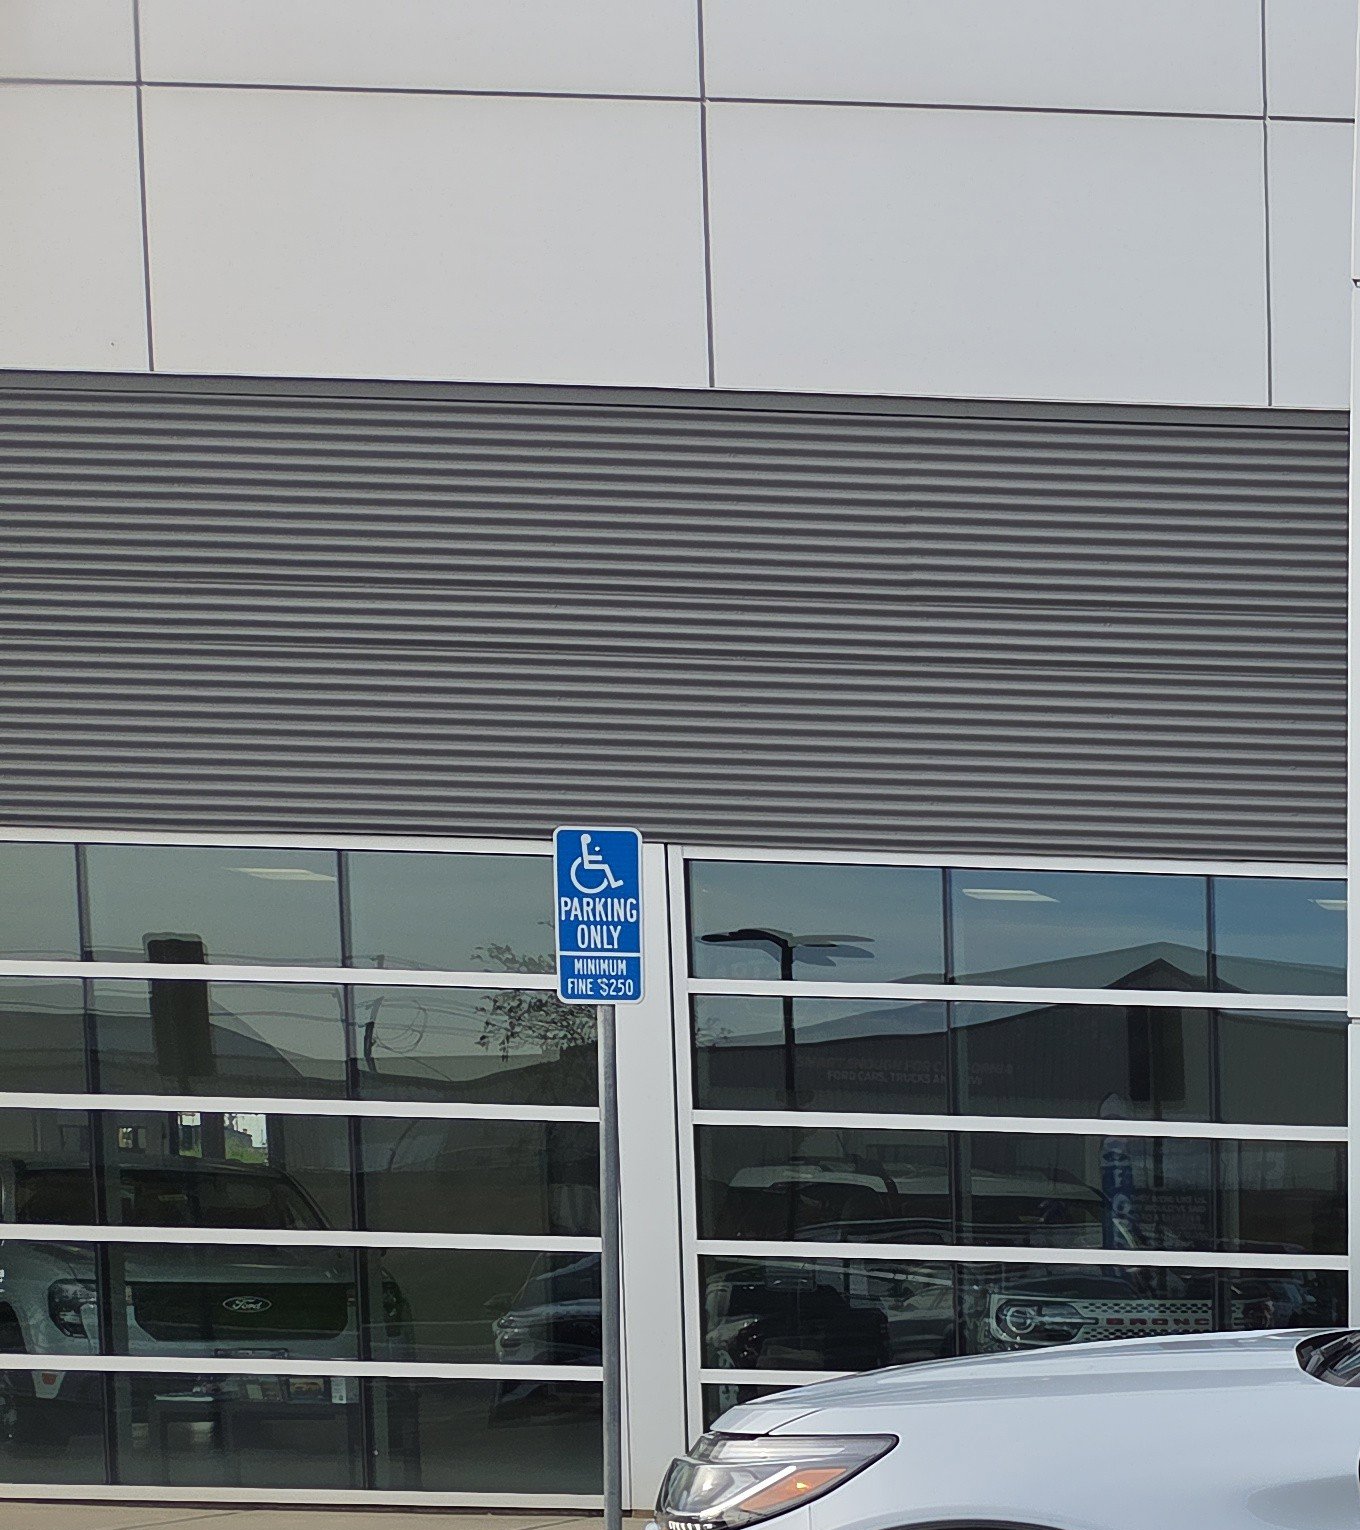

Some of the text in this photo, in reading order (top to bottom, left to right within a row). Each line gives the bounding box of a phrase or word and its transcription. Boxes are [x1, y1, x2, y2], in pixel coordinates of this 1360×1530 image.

[560, 897, 637, 923] PARKING
[577, 924, 621, 949] ONLY
[574, 958, 627, 976] MINIMUM
[567, 978, 634, 996] FINE $250
